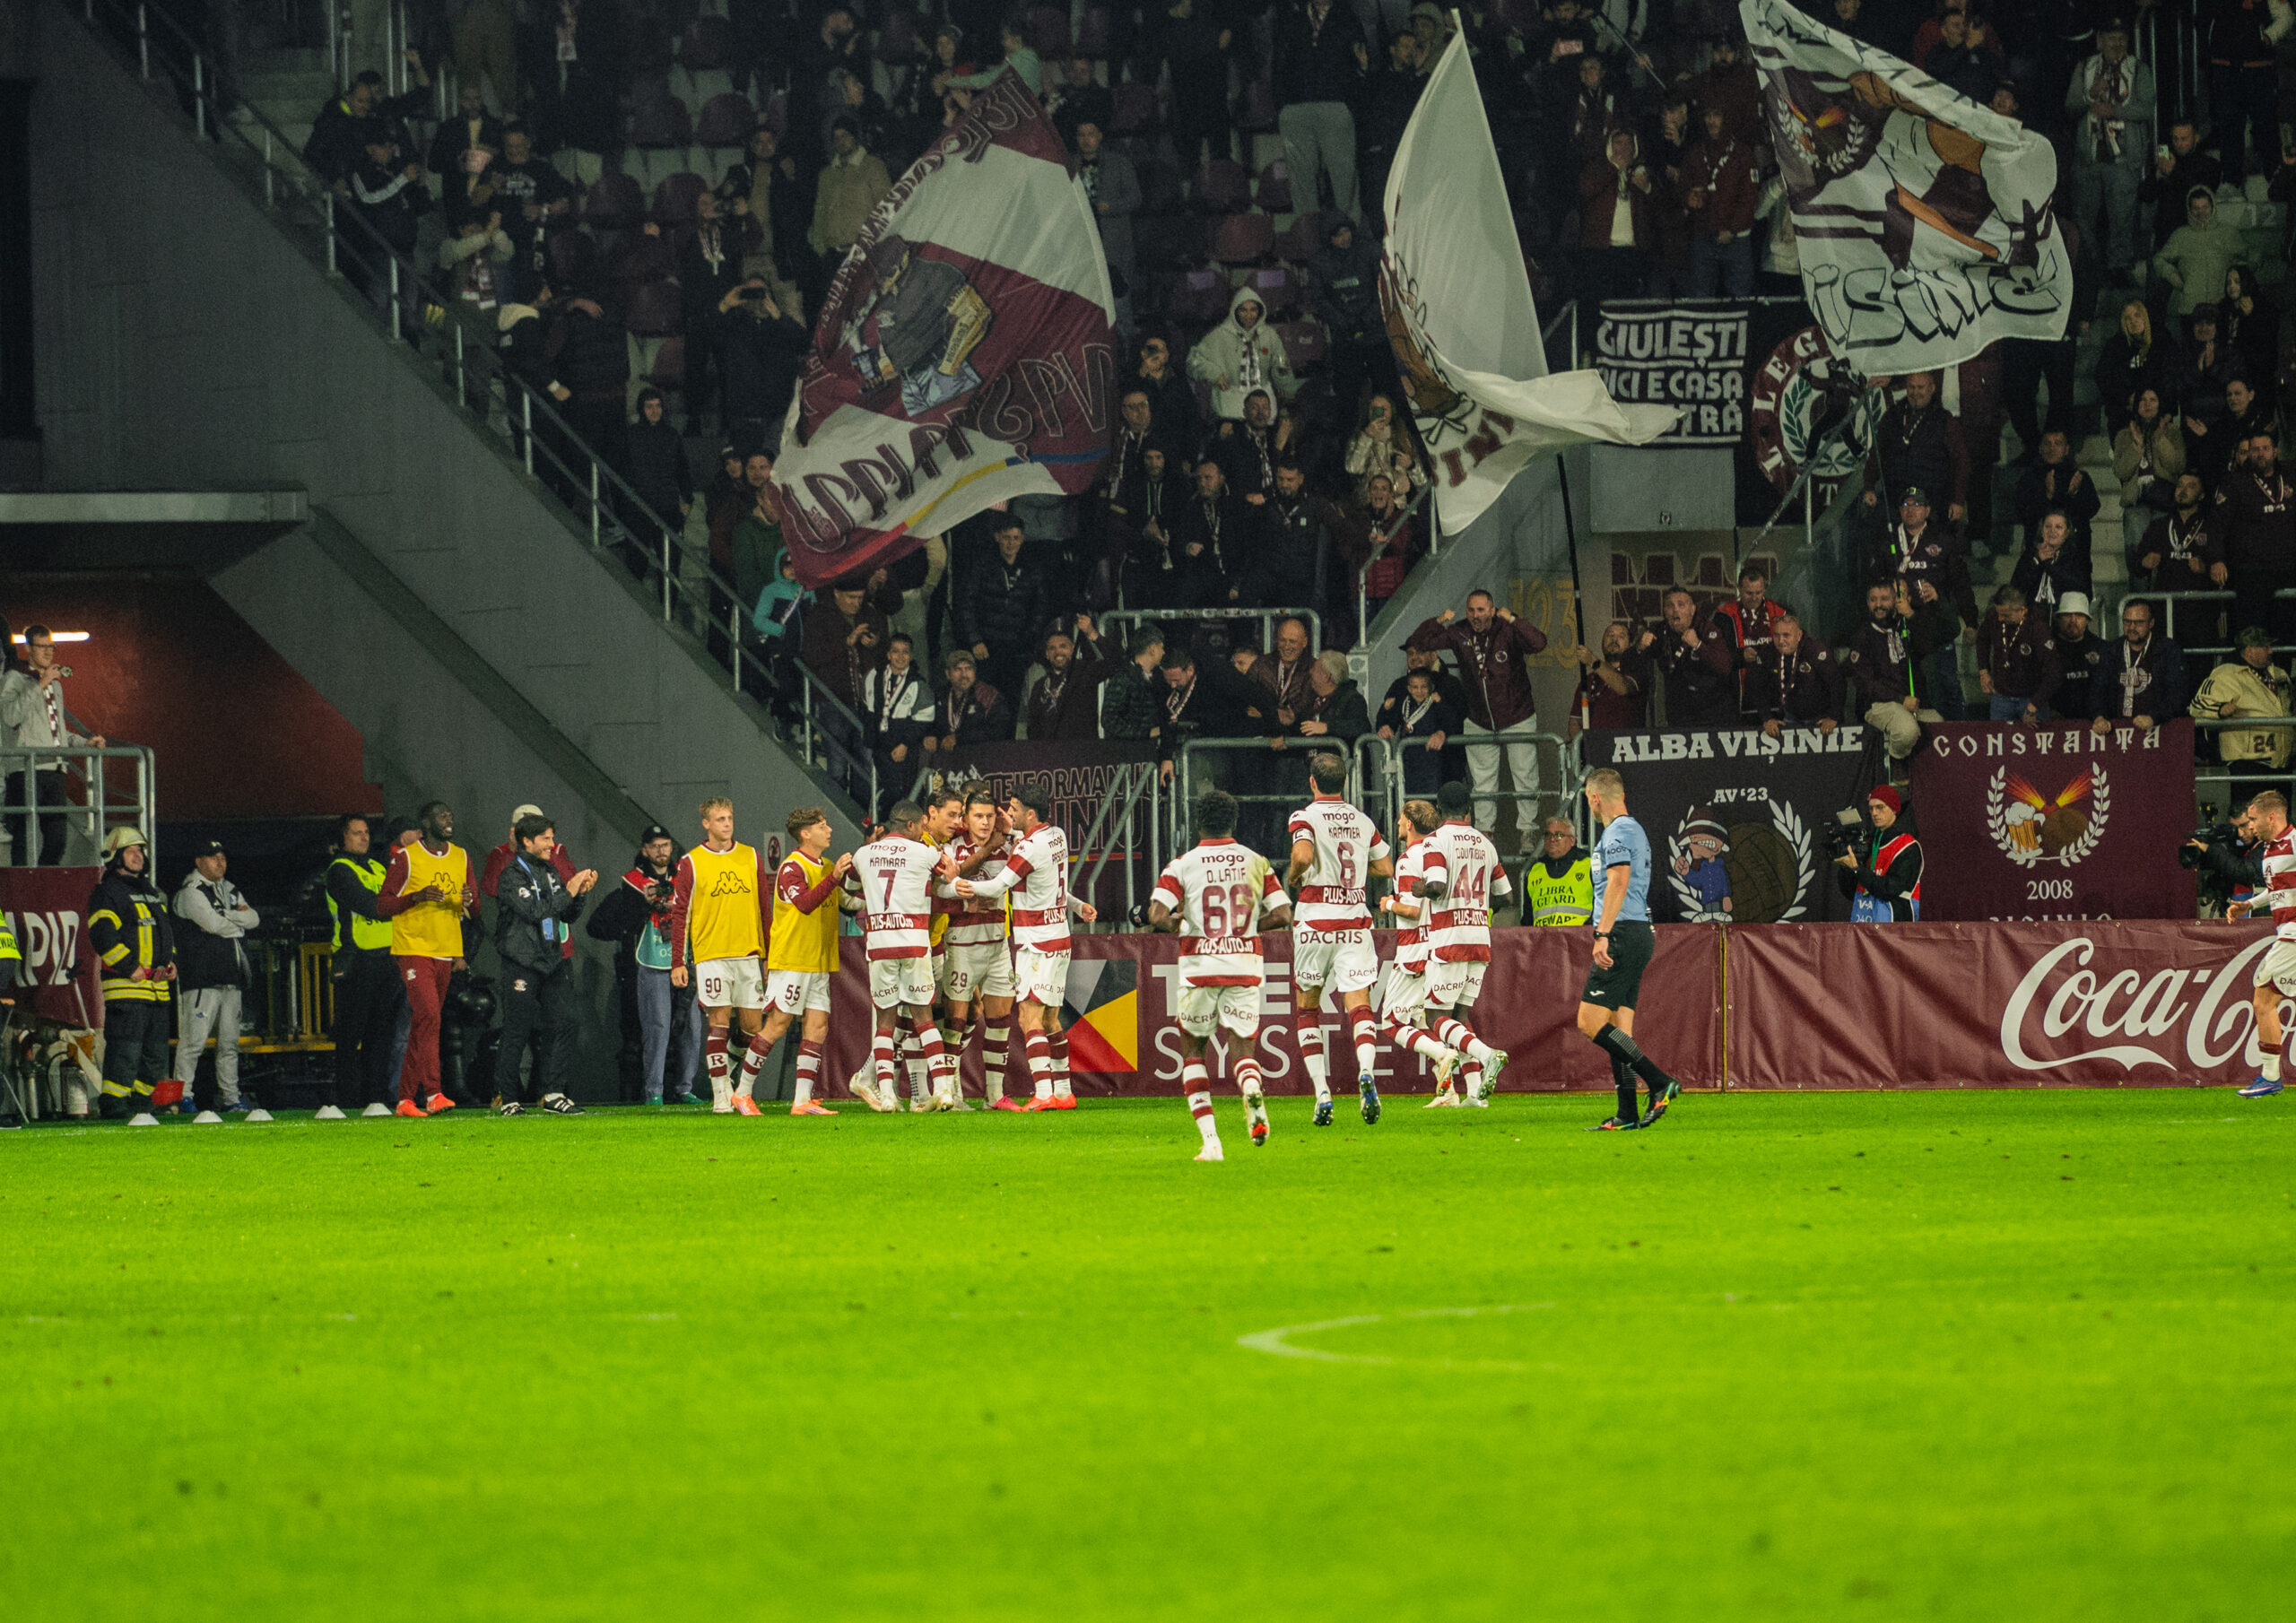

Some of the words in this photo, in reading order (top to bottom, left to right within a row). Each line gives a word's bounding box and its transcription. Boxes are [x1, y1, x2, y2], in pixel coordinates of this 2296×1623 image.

[1648, 371, 1665, 400] E
[1669, 369, 1744, 400] CASA
[1612, 732, 1715, 762] ALBA
[1718, 726, 1864, 764] VIȘINIE
[2253, 733, 2275, 754] 24
[1714, 788, 1738, 803] AV
[1323, 812, 1355, 824] mogo
[1453, 834, 1483, 846] mogo
[870, 845, 907, 855] mogo
[869, 857, 906, 867] KAMARA
[1201, 855, 1245, 867] mogo
[1337, 841, 1356, 888] 6
[1218, 867, 1247, 882] LATIF
[877, 869, 897, 912] 7
[1451, 864, 1485, 908] 44
[1539, 885, 1573, 897] LIBRA
[2026, 879, 2074, 900] 2008
[1536, 895, 1576, 908] GUARD
[1202, 884, 1254, 939] 66
[1300, 931, 1363, 944] DACRIS
[951, 971, 968, 987] 29
[1296, 971, 1323, 981] ACRIS
[705, 977, 722, 994] 90
[872, 985, 899, 998] ACRIS
[785, 985, 801, 1002] 55
[710, 1055, 725, 1066] R
[753, 1055, 763, 1066] R
[944, 1055, 955, 1066] R
